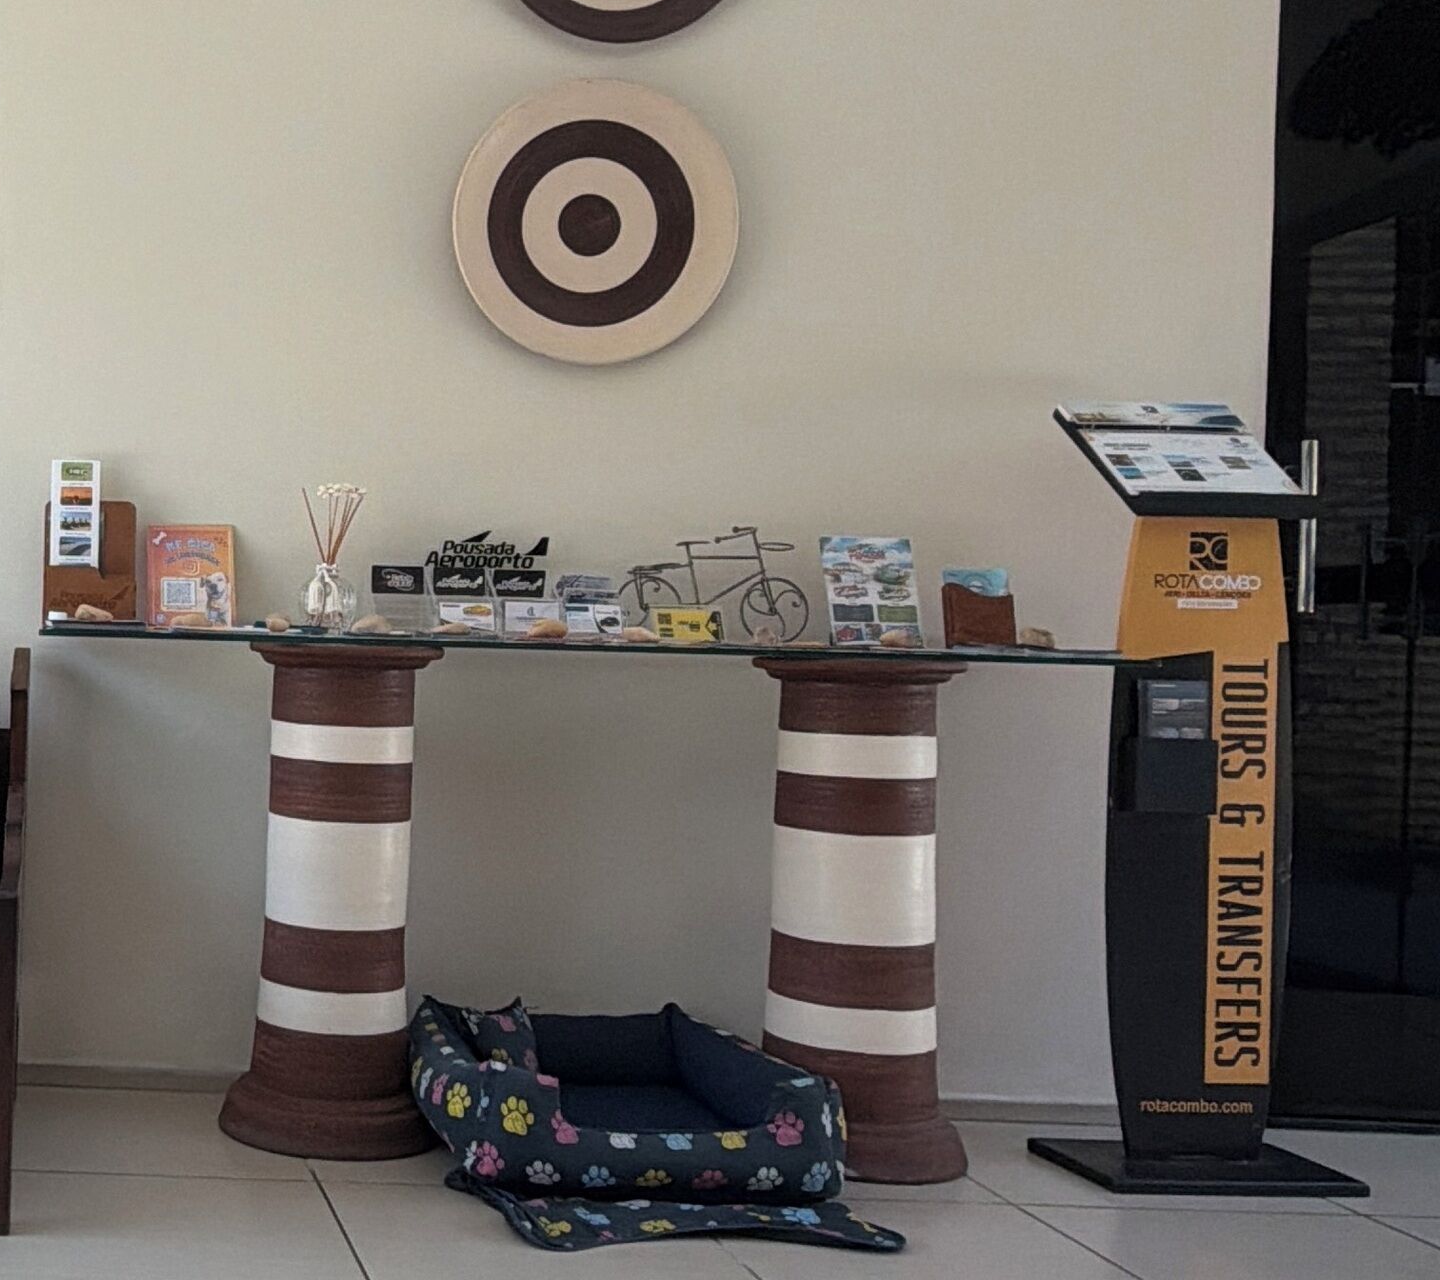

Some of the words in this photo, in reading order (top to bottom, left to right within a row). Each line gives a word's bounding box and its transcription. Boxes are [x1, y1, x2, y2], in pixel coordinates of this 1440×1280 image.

[442, 540, 516, 555] Pousada
[424, 551, 535, 569] Aeroporto
[1220, 658, 1269, 780] TOURS
[1219, 803, 1265, 828] &
[1213, 851, 1265, 1069] TRANSFERS
[1139, 1099, 1254, 1114] rotacombo.com
